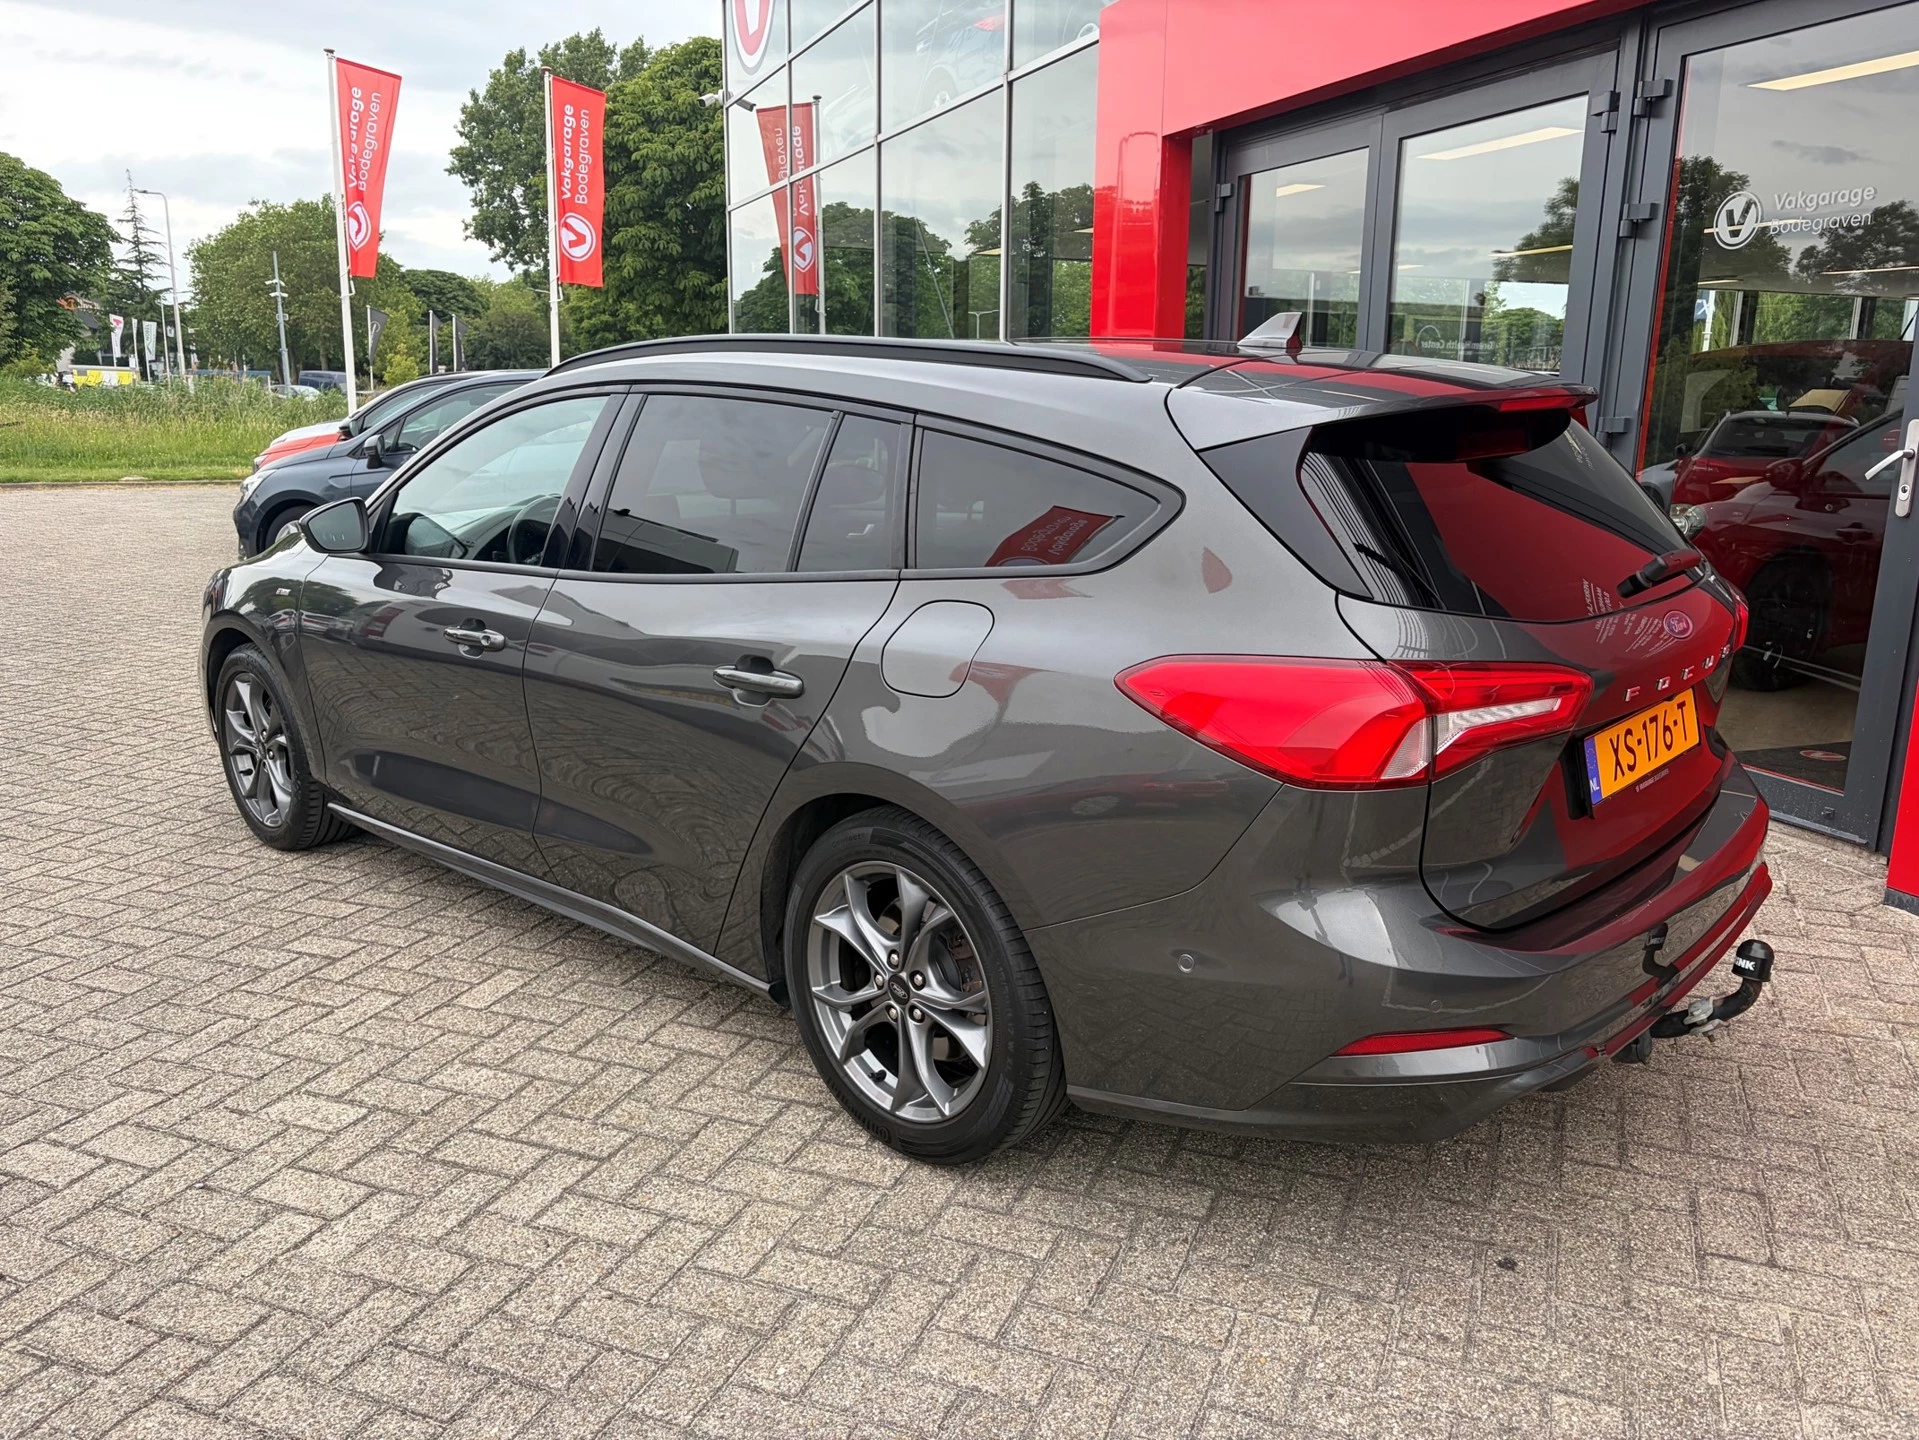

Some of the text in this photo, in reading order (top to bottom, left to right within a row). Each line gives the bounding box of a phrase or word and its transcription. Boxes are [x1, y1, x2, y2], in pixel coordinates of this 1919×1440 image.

[357, 92, 381, 191] Bodegraven
[560, 104, 576, 200] Vakgarage
[575, 109, 592, 205] Bodegraven
[1769, 213, 1873, 235] Bodegraven
[1774, 186, 1877, 212] Vakgarage
[1624, 644, 1731, 702] FOCUS
[1609, 700, 1687, 782] XS-176-T
[1589, 777, 1600, 793] NL
